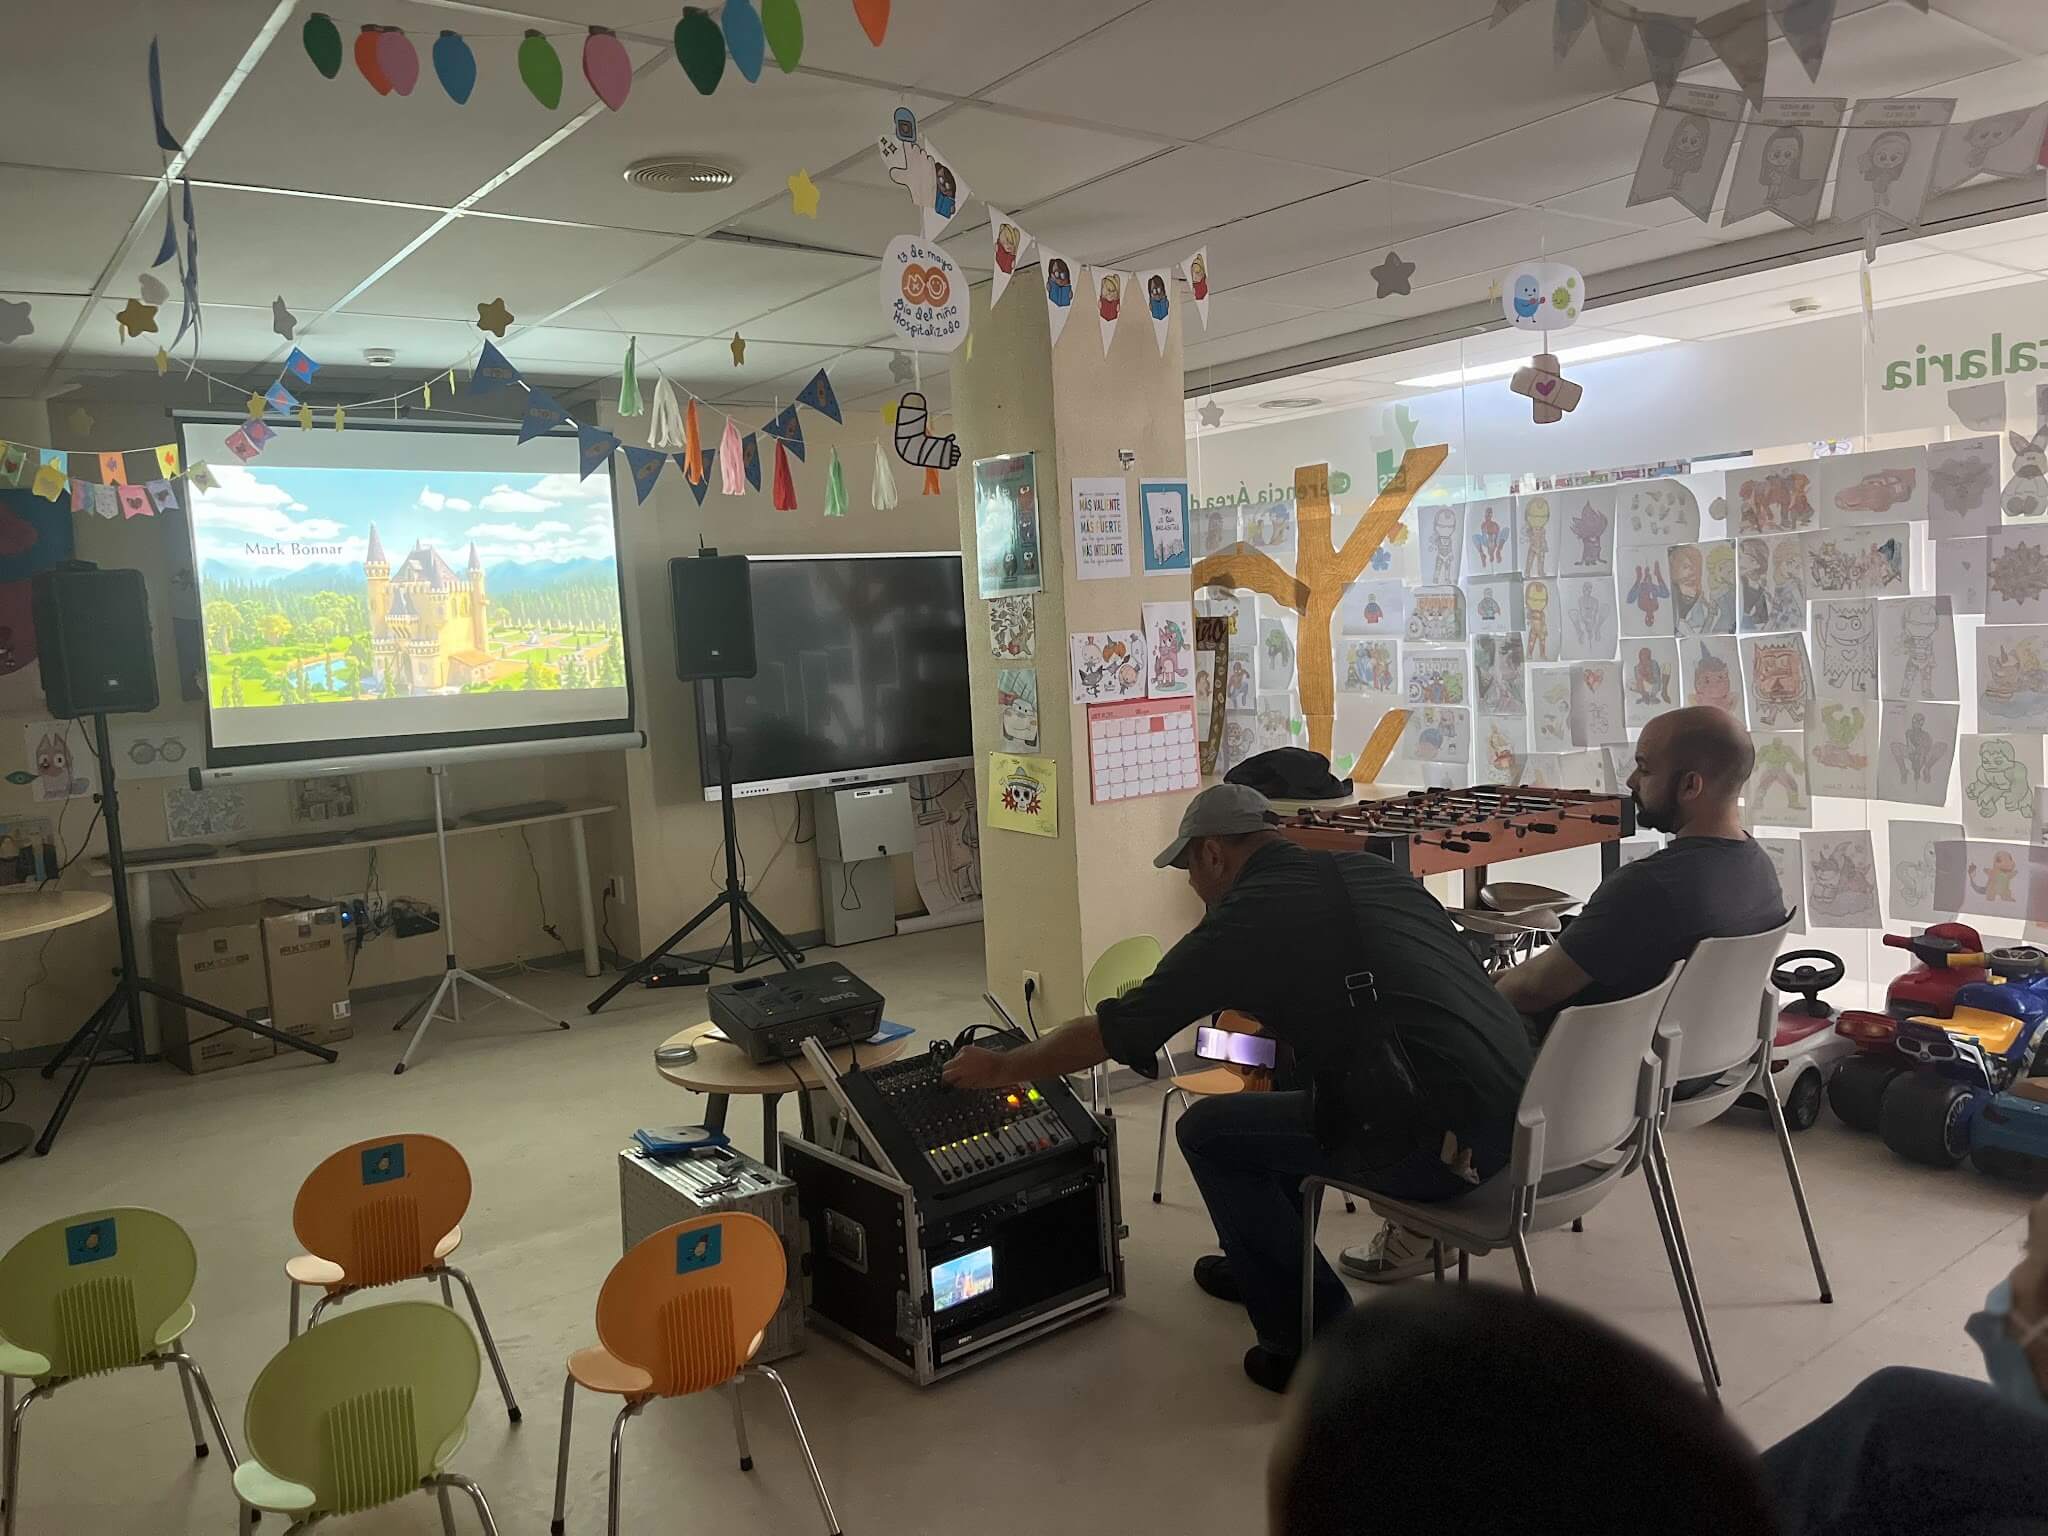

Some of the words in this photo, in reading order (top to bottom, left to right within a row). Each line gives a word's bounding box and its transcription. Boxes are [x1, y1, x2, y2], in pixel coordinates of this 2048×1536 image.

[898, 252, 908, 263] 13
[911, 244, 924, 259] de
[927, 251, 953, 271] mayo
[915, 307, 933, 321] del
[936, 305, 957, 320] niño
[893, 310, 960, 338] Hospitalizado
[1093, 498, 1121, 512] VALIENTE
[245, 542, 286, 556] Mark
[291, 542, 343, 556] Bonnar
